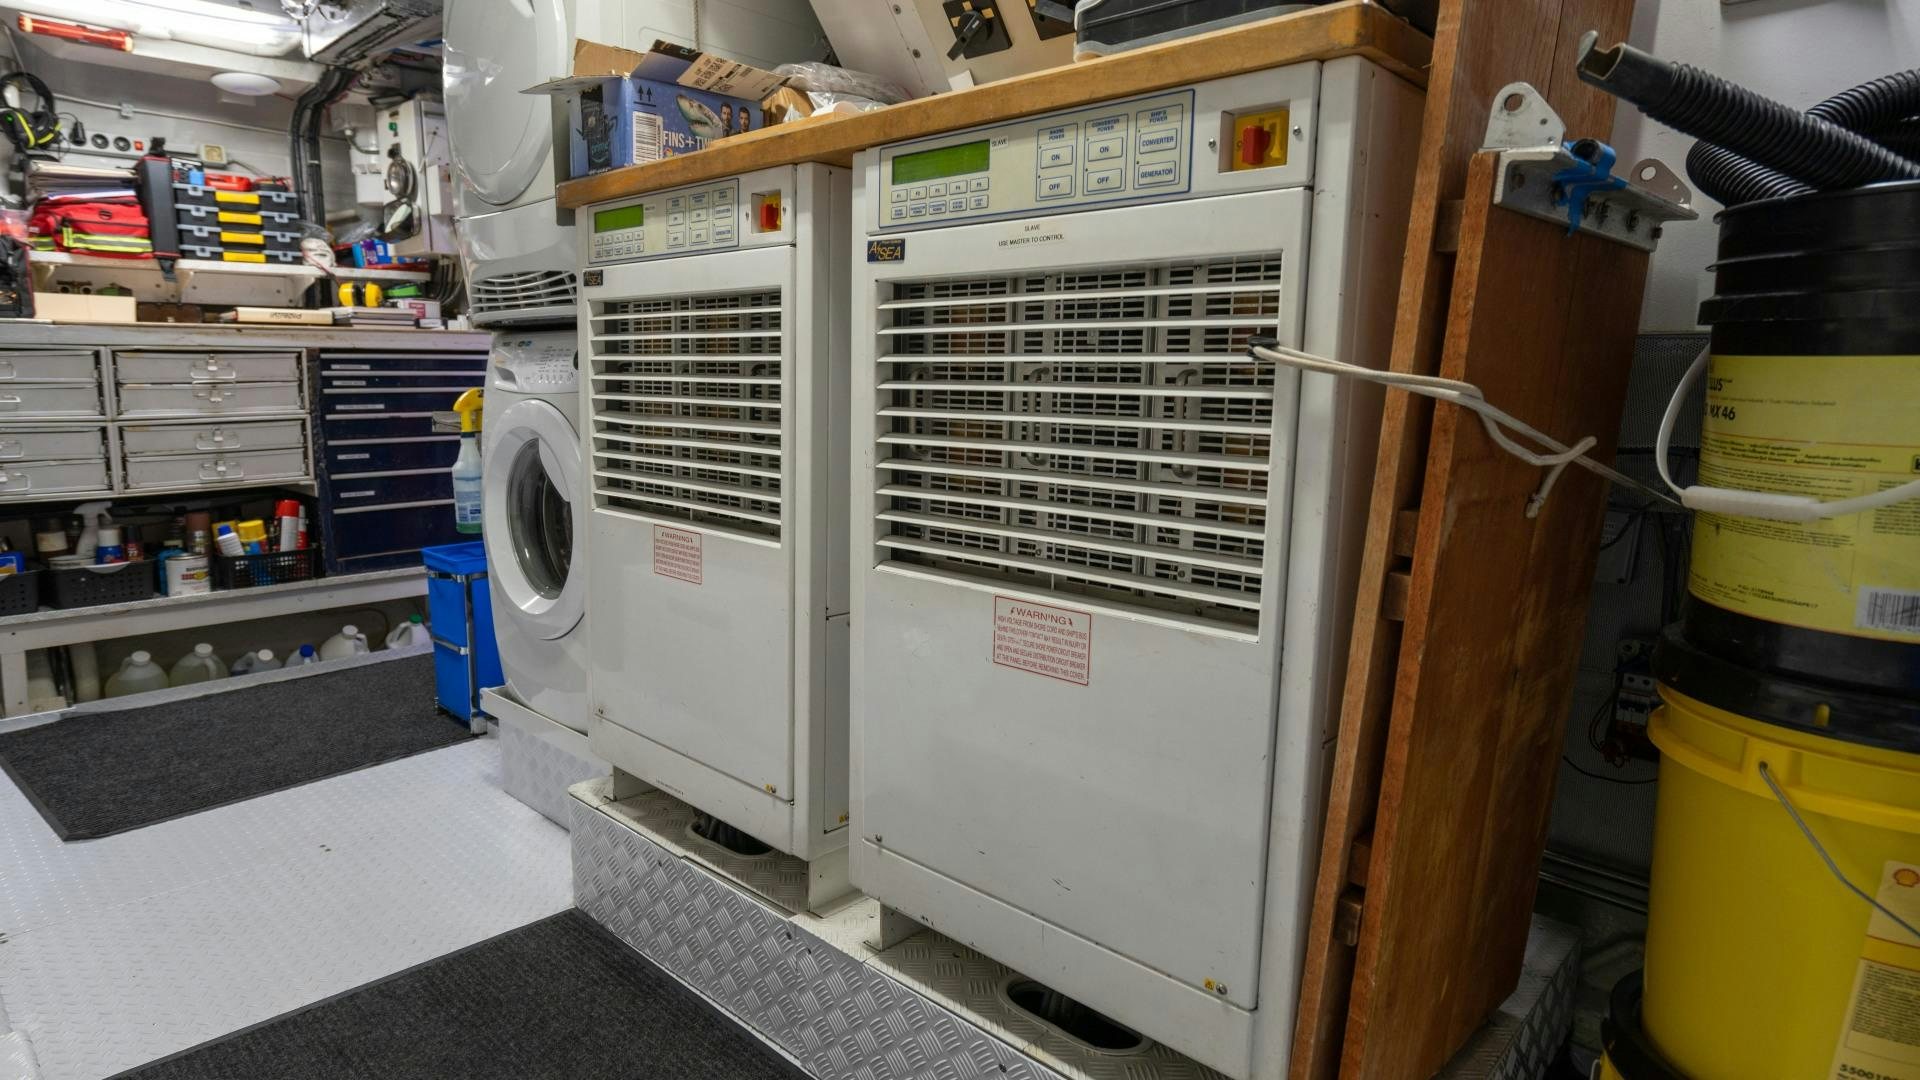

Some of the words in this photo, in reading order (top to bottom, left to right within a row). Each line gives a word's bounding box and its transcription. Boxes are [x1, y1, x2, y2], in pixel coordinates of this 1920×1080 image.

[1142, 136, 1174, 146] CONVERTER
[1140, 168, 1173, 178] GENERATOR
[1097, 176, 1110, 184] OFF
[1039, 234, 1064, 242] CONTROL
[1722, 406, 1736, 420] 46
[1016, 607, 1066, 624] WARNING
